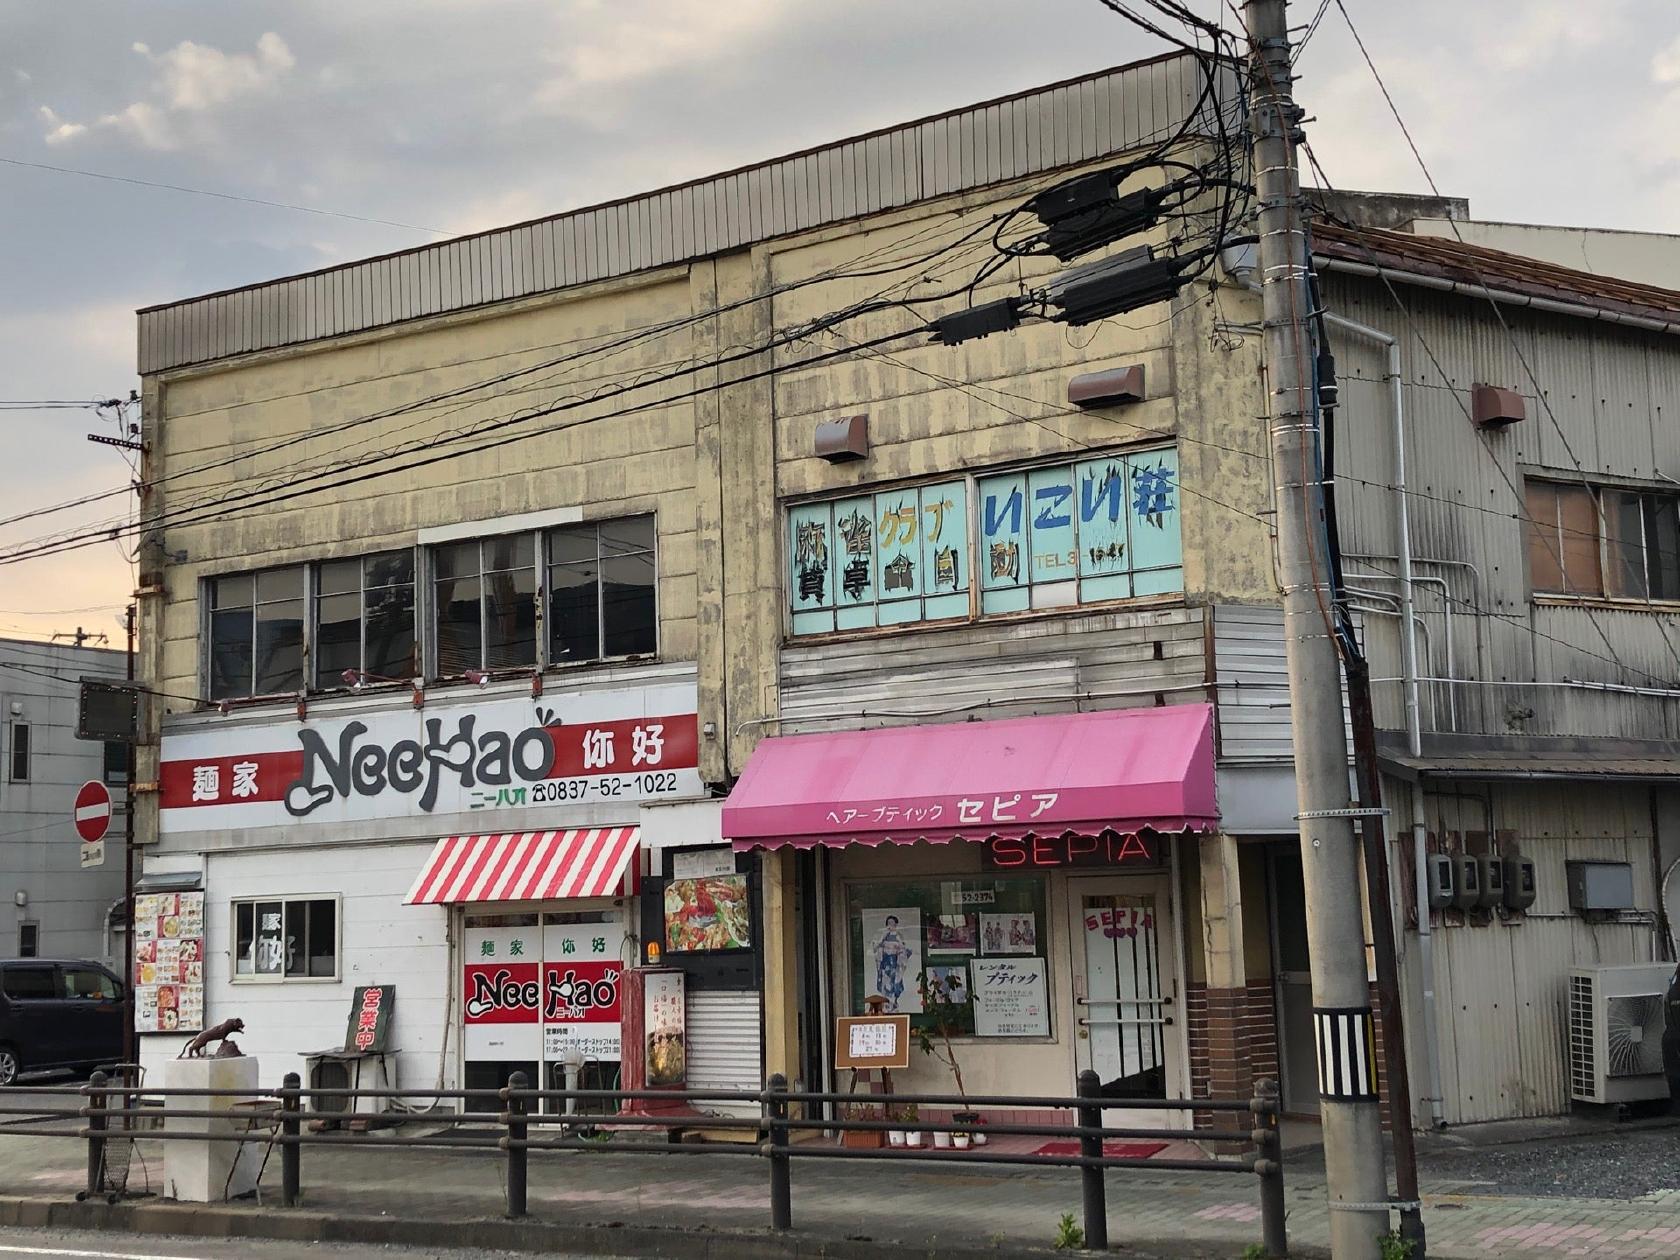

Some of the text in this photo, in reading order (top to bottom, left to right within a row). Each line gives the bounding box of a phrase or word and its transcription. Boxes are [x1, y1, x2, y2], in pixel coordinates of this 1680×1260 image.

[582, 725, 665, 769] 你好
[470, 786, 527, 809] ニーハオ
[547, 773, 677, 801] 0837-52-1022
[957, 794, 1058, 823] セピア
[992, 835, 1150, 865] SEPIA
[562, 937, 605, 954] 你好
[355, 988, 382, 1051] 営業中
